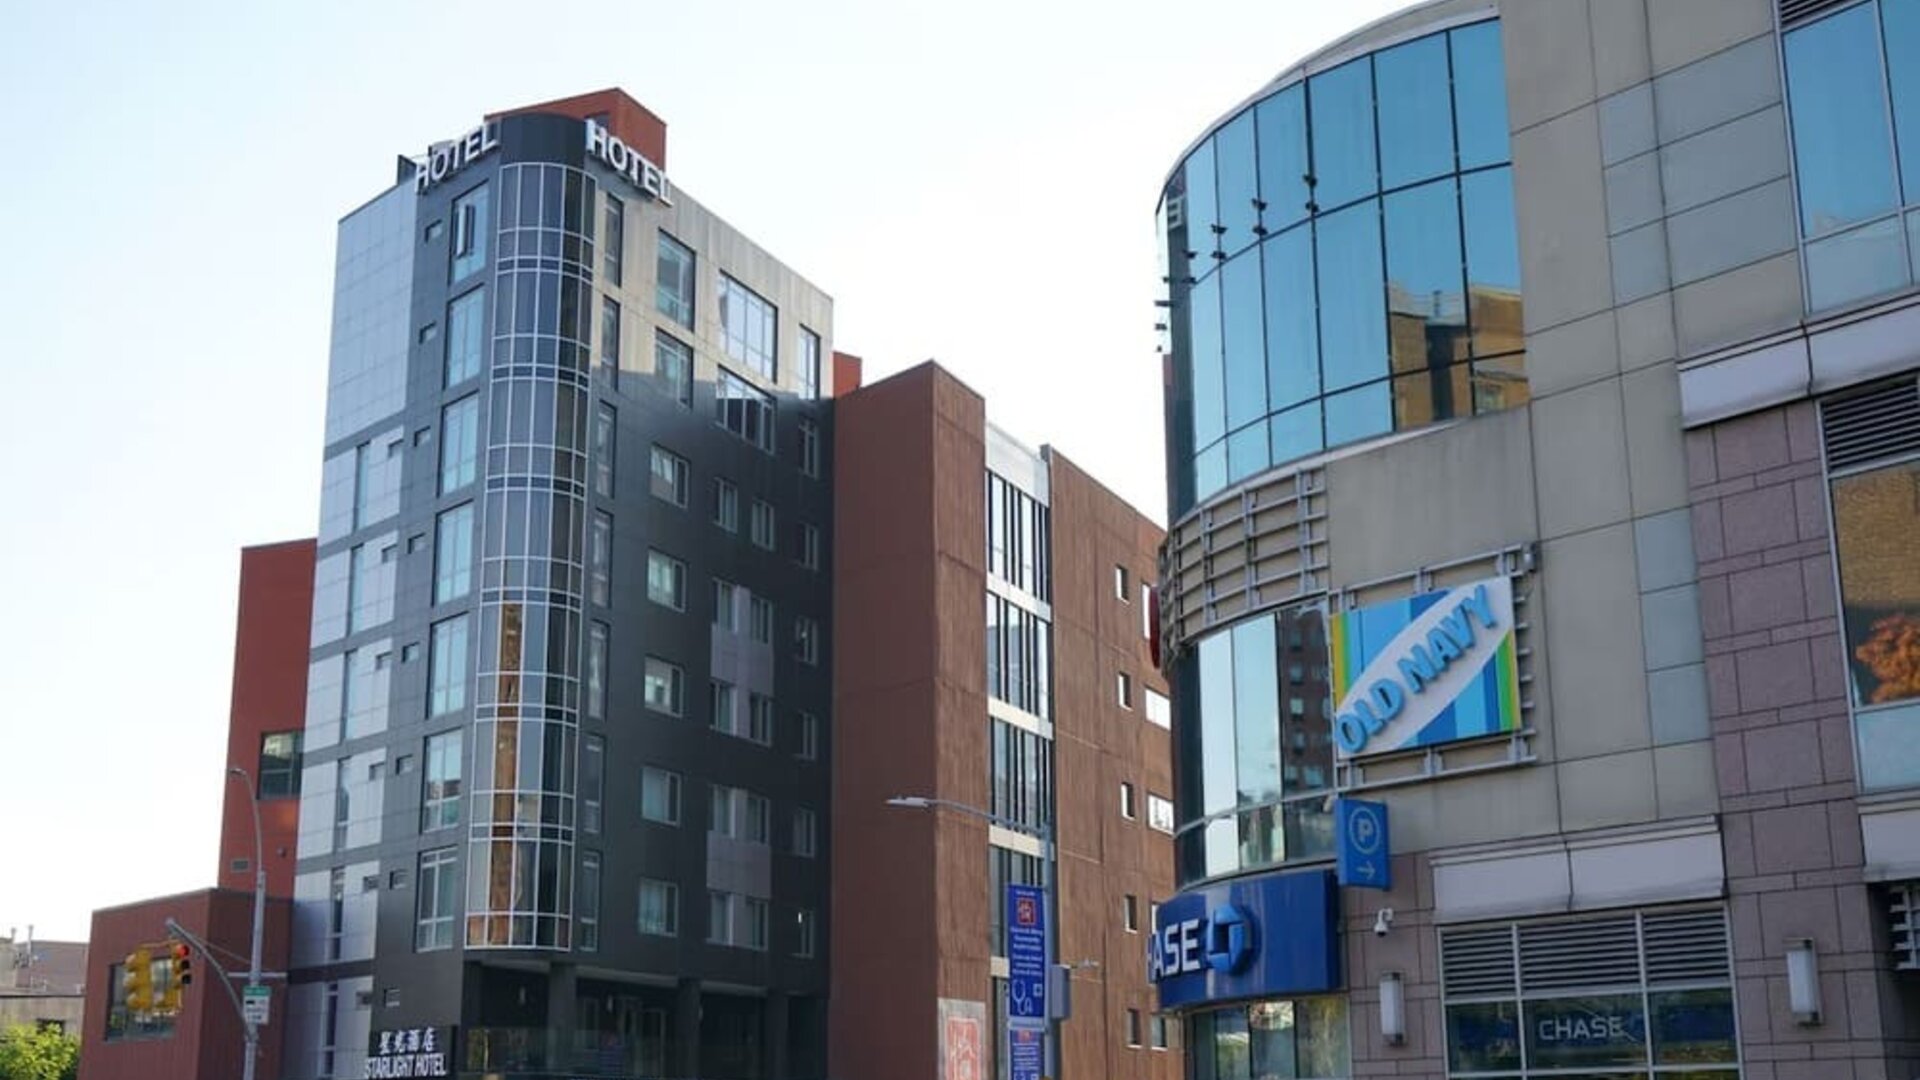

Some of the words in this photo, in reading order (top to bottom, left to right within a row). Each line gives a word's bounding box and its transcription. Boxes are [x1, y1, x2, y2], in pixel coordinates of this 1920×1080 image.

[415, 121, 499, 192] HOTEL
[585, 118, 674, 207] HOTEL
[1335, 677, 1405, 753] OLD
[1397, 584, 1497, 694] NAVY
[1148, 918, 1201, 983] ASE
[1539, 1016, 1623, 1040] CHASE
[414, 1052, 448, 1077] HOTEL
